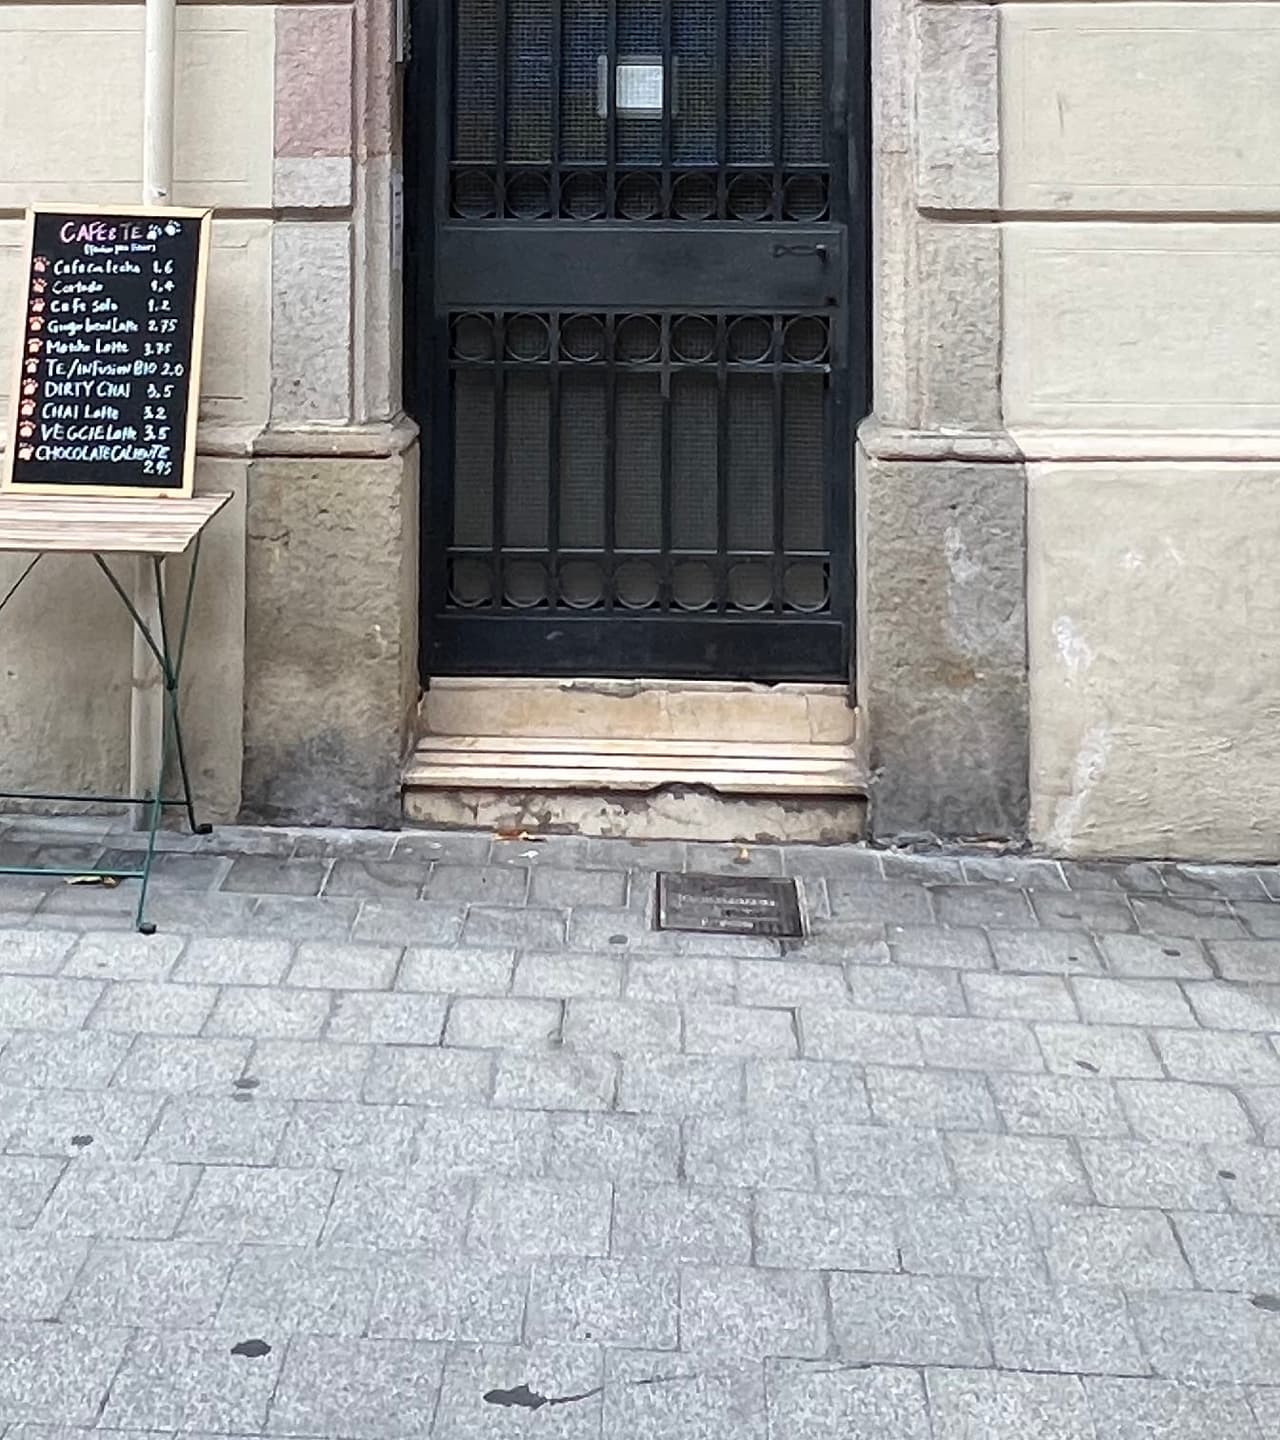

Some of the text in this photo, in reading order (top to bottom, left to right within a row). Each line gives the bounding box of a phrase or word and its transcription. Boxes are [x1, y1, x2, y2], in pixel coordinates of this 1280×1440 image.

[153, 259, 174, 274] 1.6
[160, 363, 184, 376] 2.0
[45, 380, 175, 398] DIRTY CHAI 3.5
[42, 403, 79, 419] CHAI
[35, 445, 111, 461] CHOCOLATE
